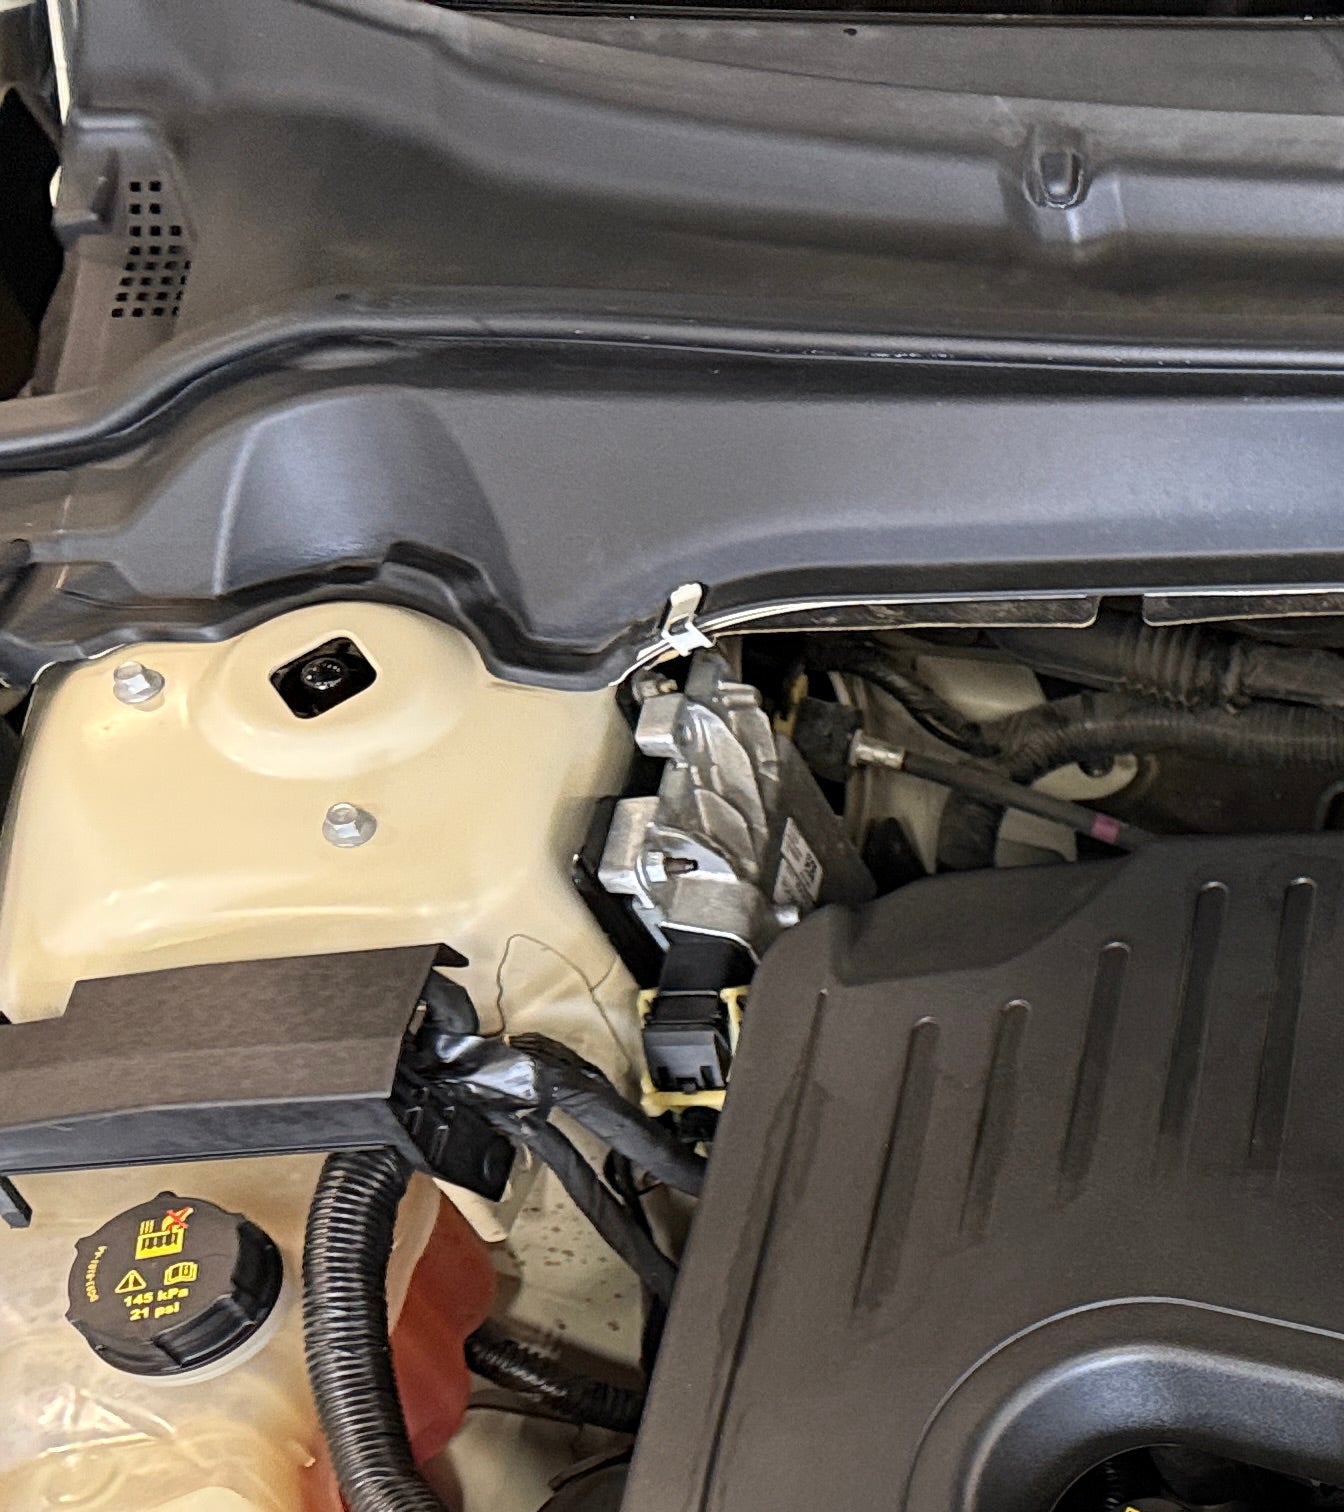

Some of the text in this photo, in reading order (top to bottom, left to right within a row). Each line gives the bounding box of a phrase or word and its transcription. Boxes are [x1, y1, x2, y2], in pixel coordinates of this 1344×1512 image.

[124, 1287, 189, 1308] 145 kPa
[129, 1302, 181, 1321] 21 psi
